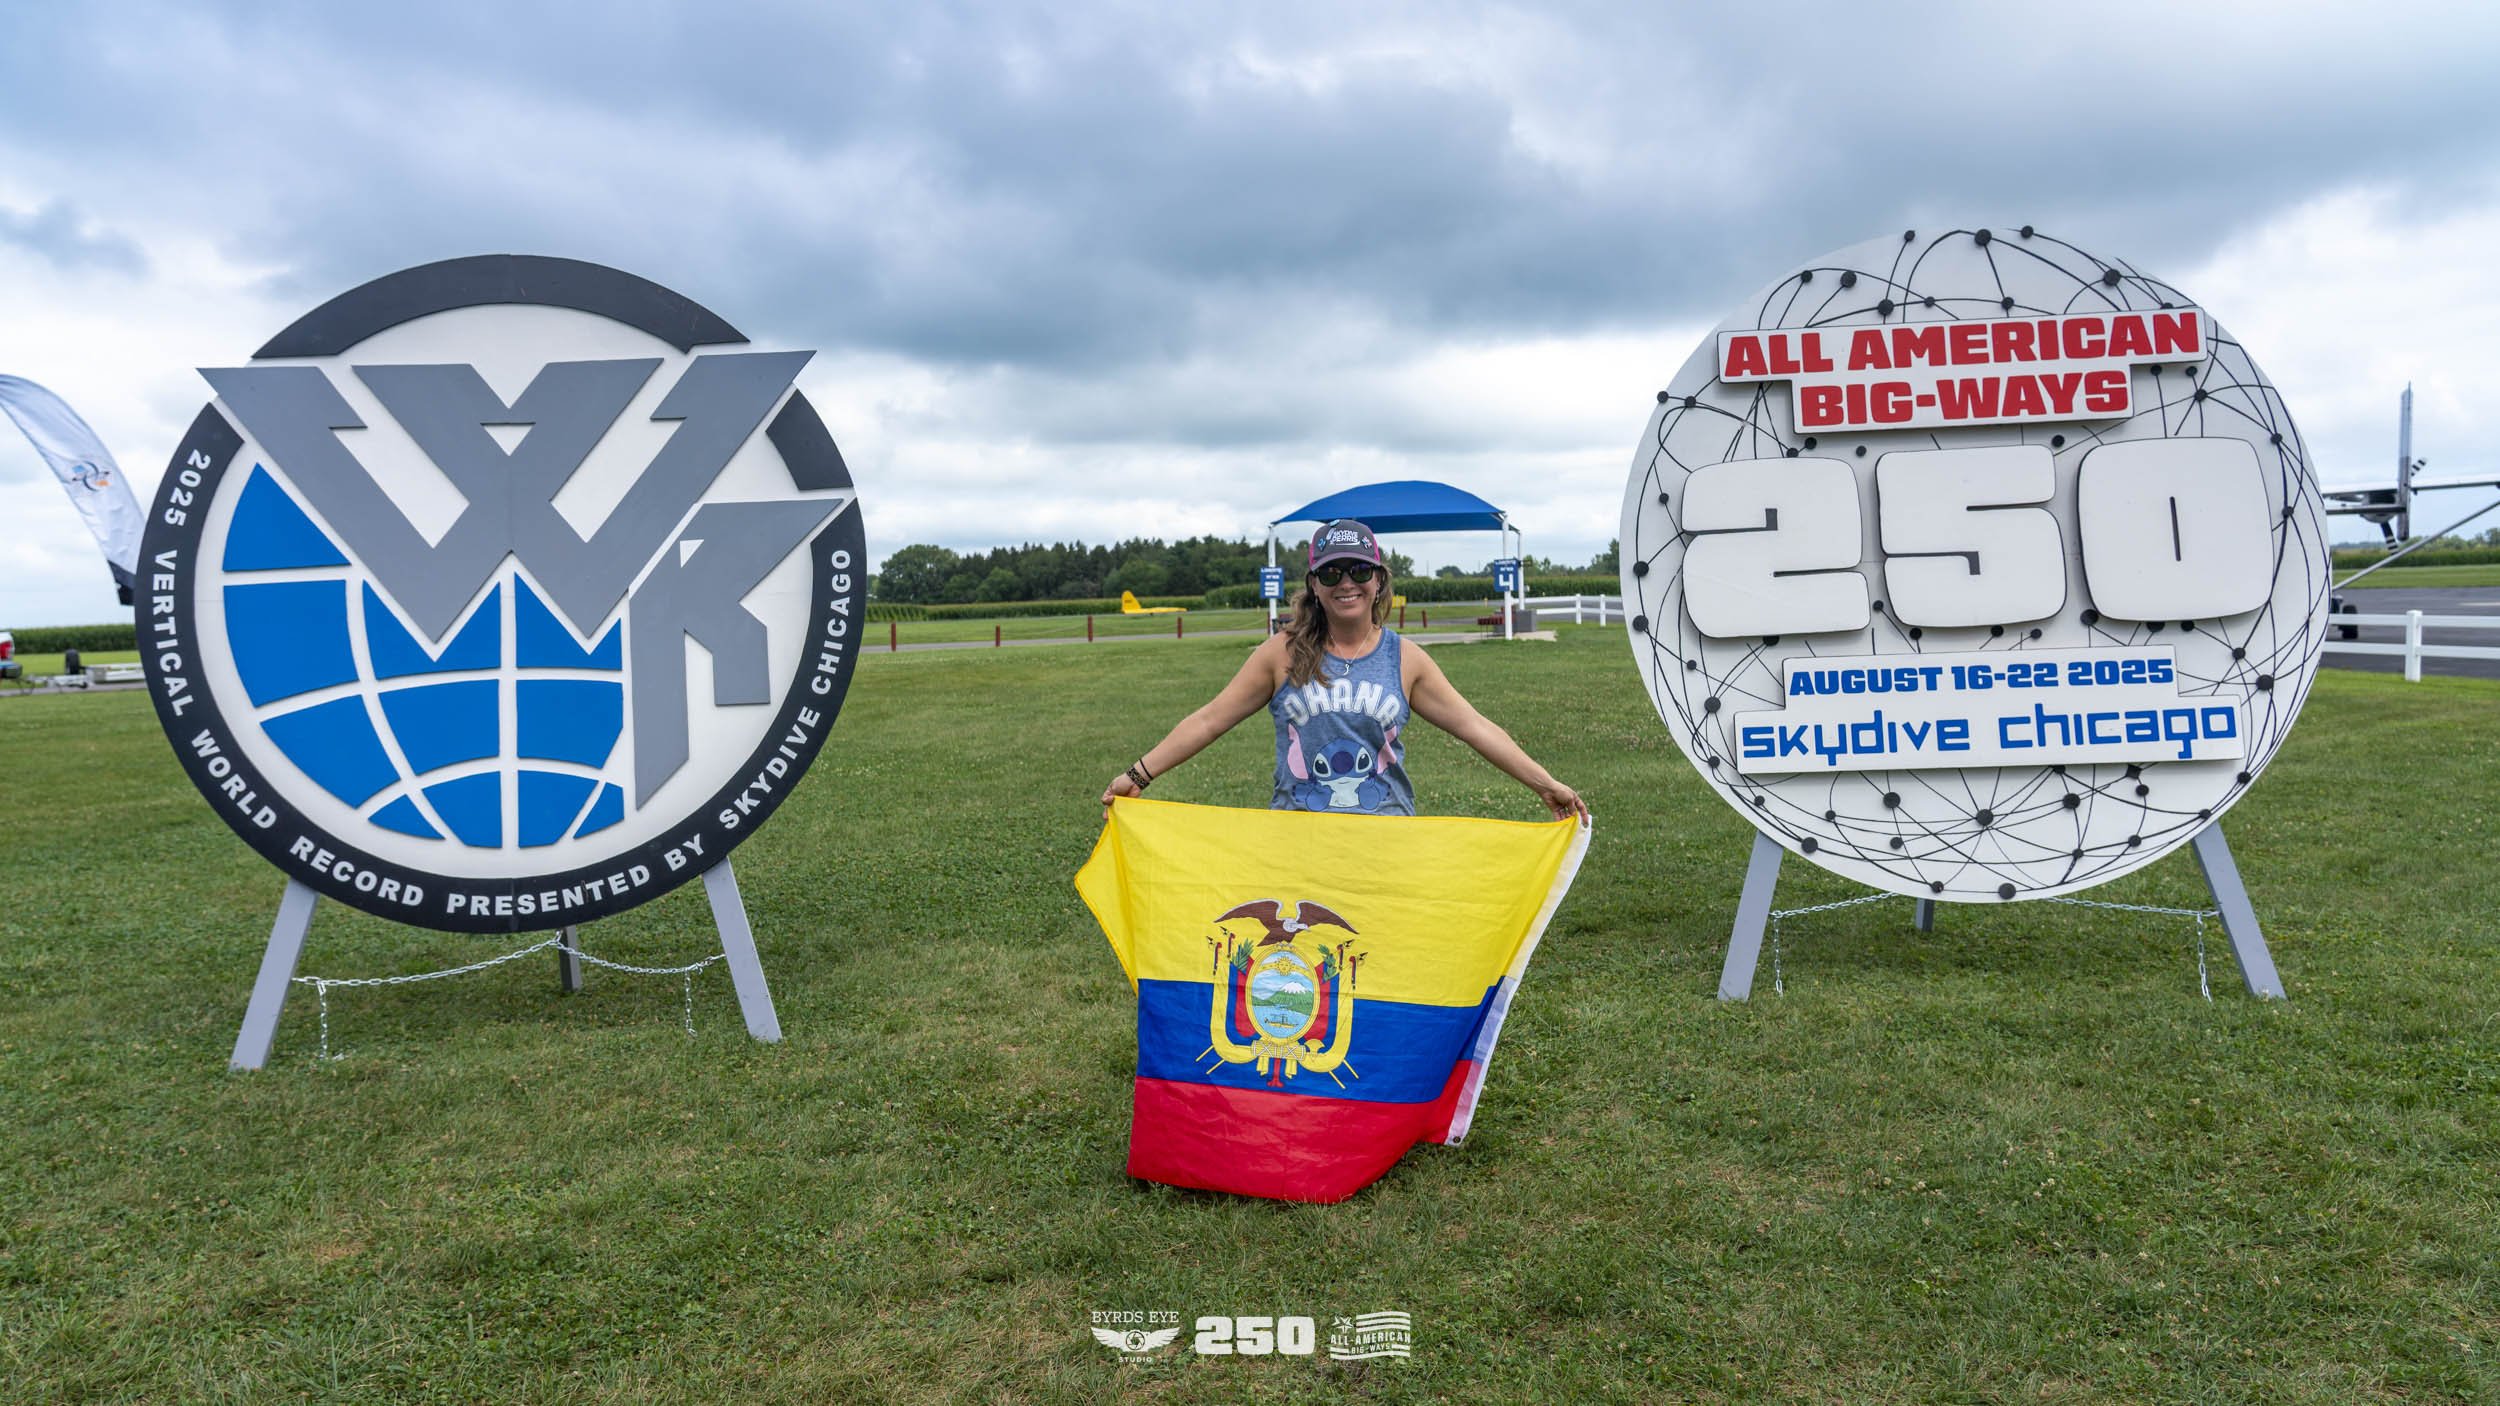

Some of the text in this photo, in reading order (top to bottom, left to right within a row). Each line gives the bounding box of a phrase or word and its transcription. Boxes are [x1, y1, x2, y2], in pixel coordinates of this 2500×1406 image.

[1725, 312, 2199, 377] ALL AMERICAN
[1800, 370, 2128, 427] BIG-WAYS
[1681, 436, 2275, 638] 250
[1264, 581, 1280, 597] 3
[1498, 573, 1514, 591] 4
[152, 449, 851, 916] 2025 VERTICAL WORLD RECORD PRESENTED BY SKYDIVE CHICAGO
[1284, 678, 1401, 726] OHANA
[1789, 658, 2174, 696] AUGUST 16-22 2025
[1742, 703, 2237, 766] skydive chicago
